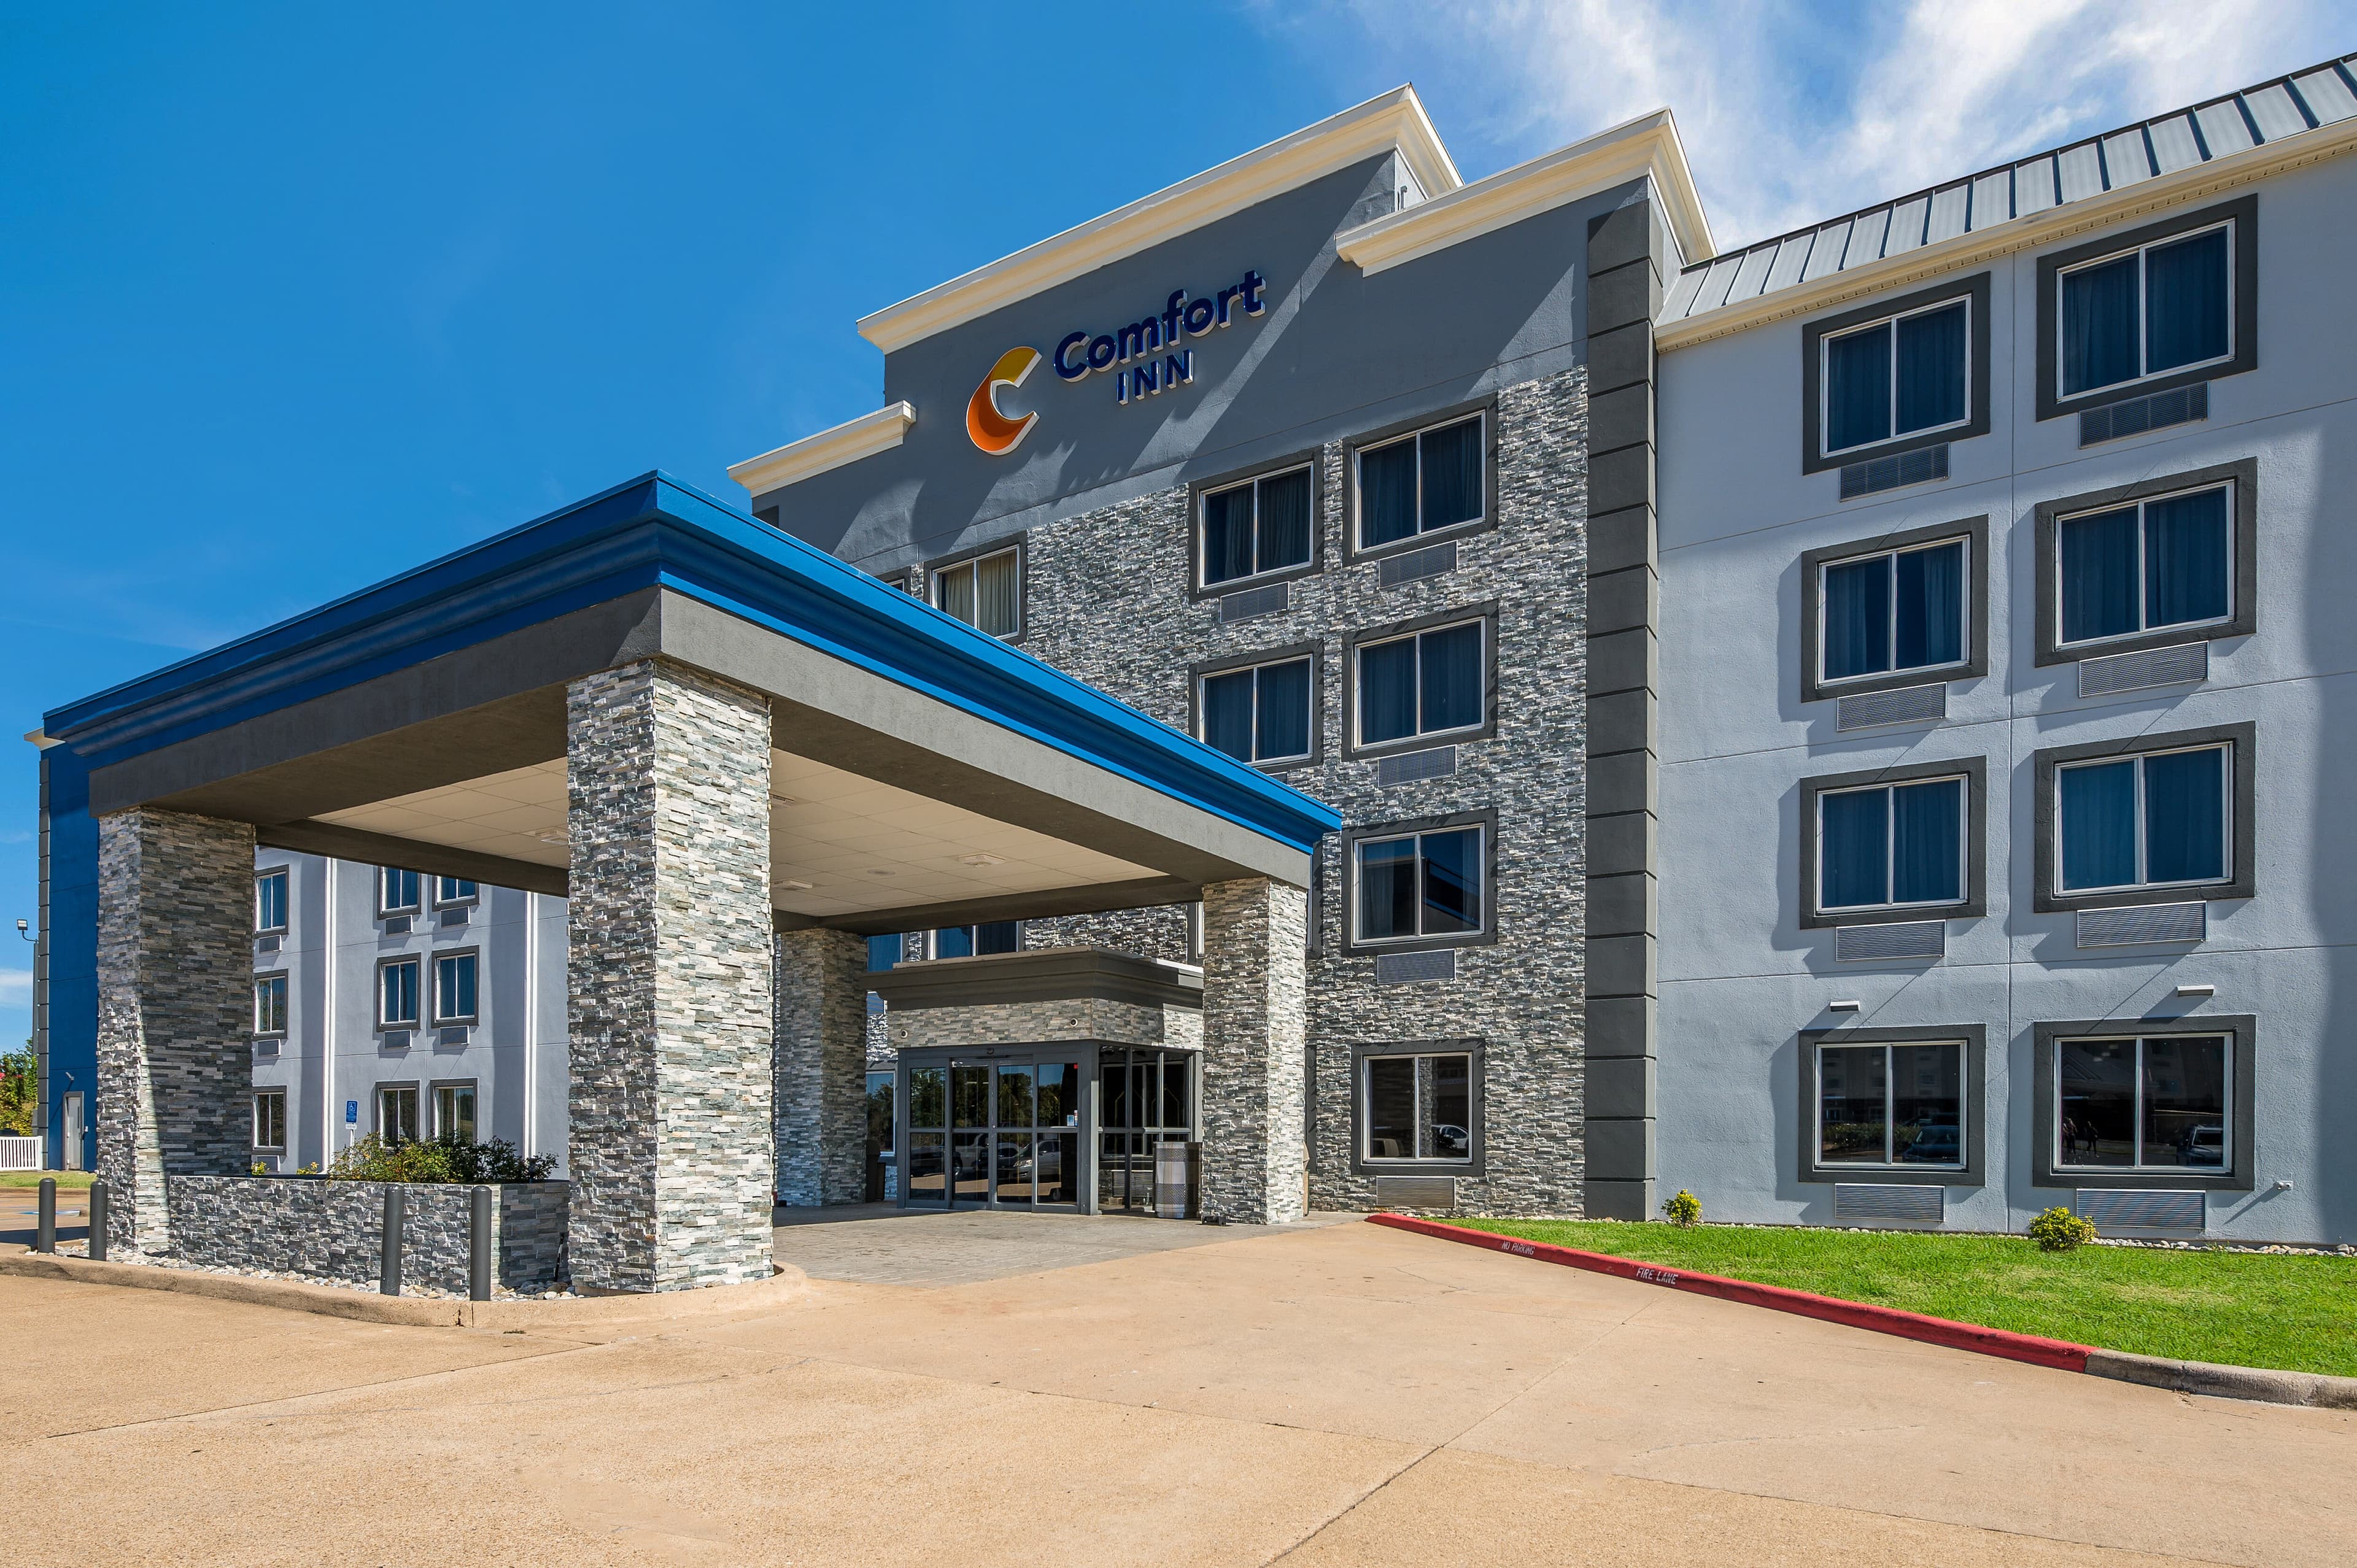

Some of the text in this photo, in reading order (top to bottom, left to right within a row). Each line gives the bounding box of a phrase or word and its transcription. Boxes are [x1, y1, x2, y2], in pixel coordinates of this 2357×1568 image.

[1054, 270, 1266, 382] Comfort
[1116, 349, 1194, 405] INN
[1501, 1240, 1535, 1255] NO PARKING
[1636, 1267, 1678, 1285] FIRE LANE
